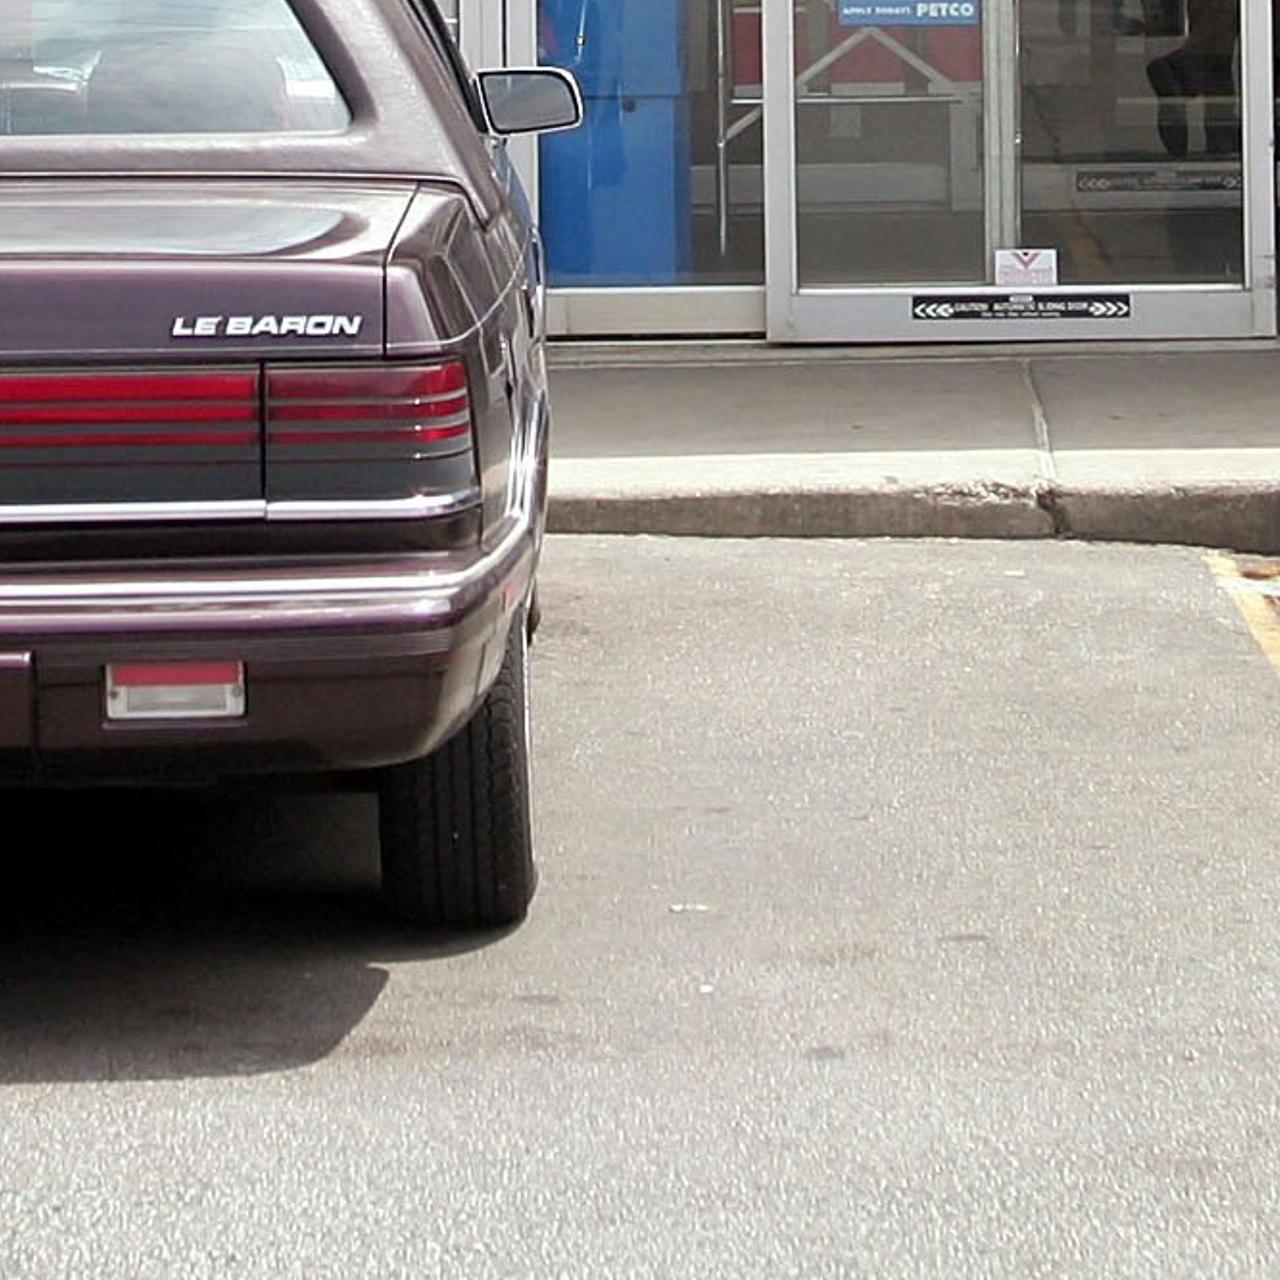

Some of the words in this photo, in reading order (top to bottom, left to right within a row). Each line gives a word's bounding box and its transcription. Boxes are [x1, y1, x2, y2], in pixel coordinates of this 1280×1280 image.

[916, 2, 975, 17] PETCO
[170, 316, 219, 338] LE
[223, 313, 362, 337] BARON
